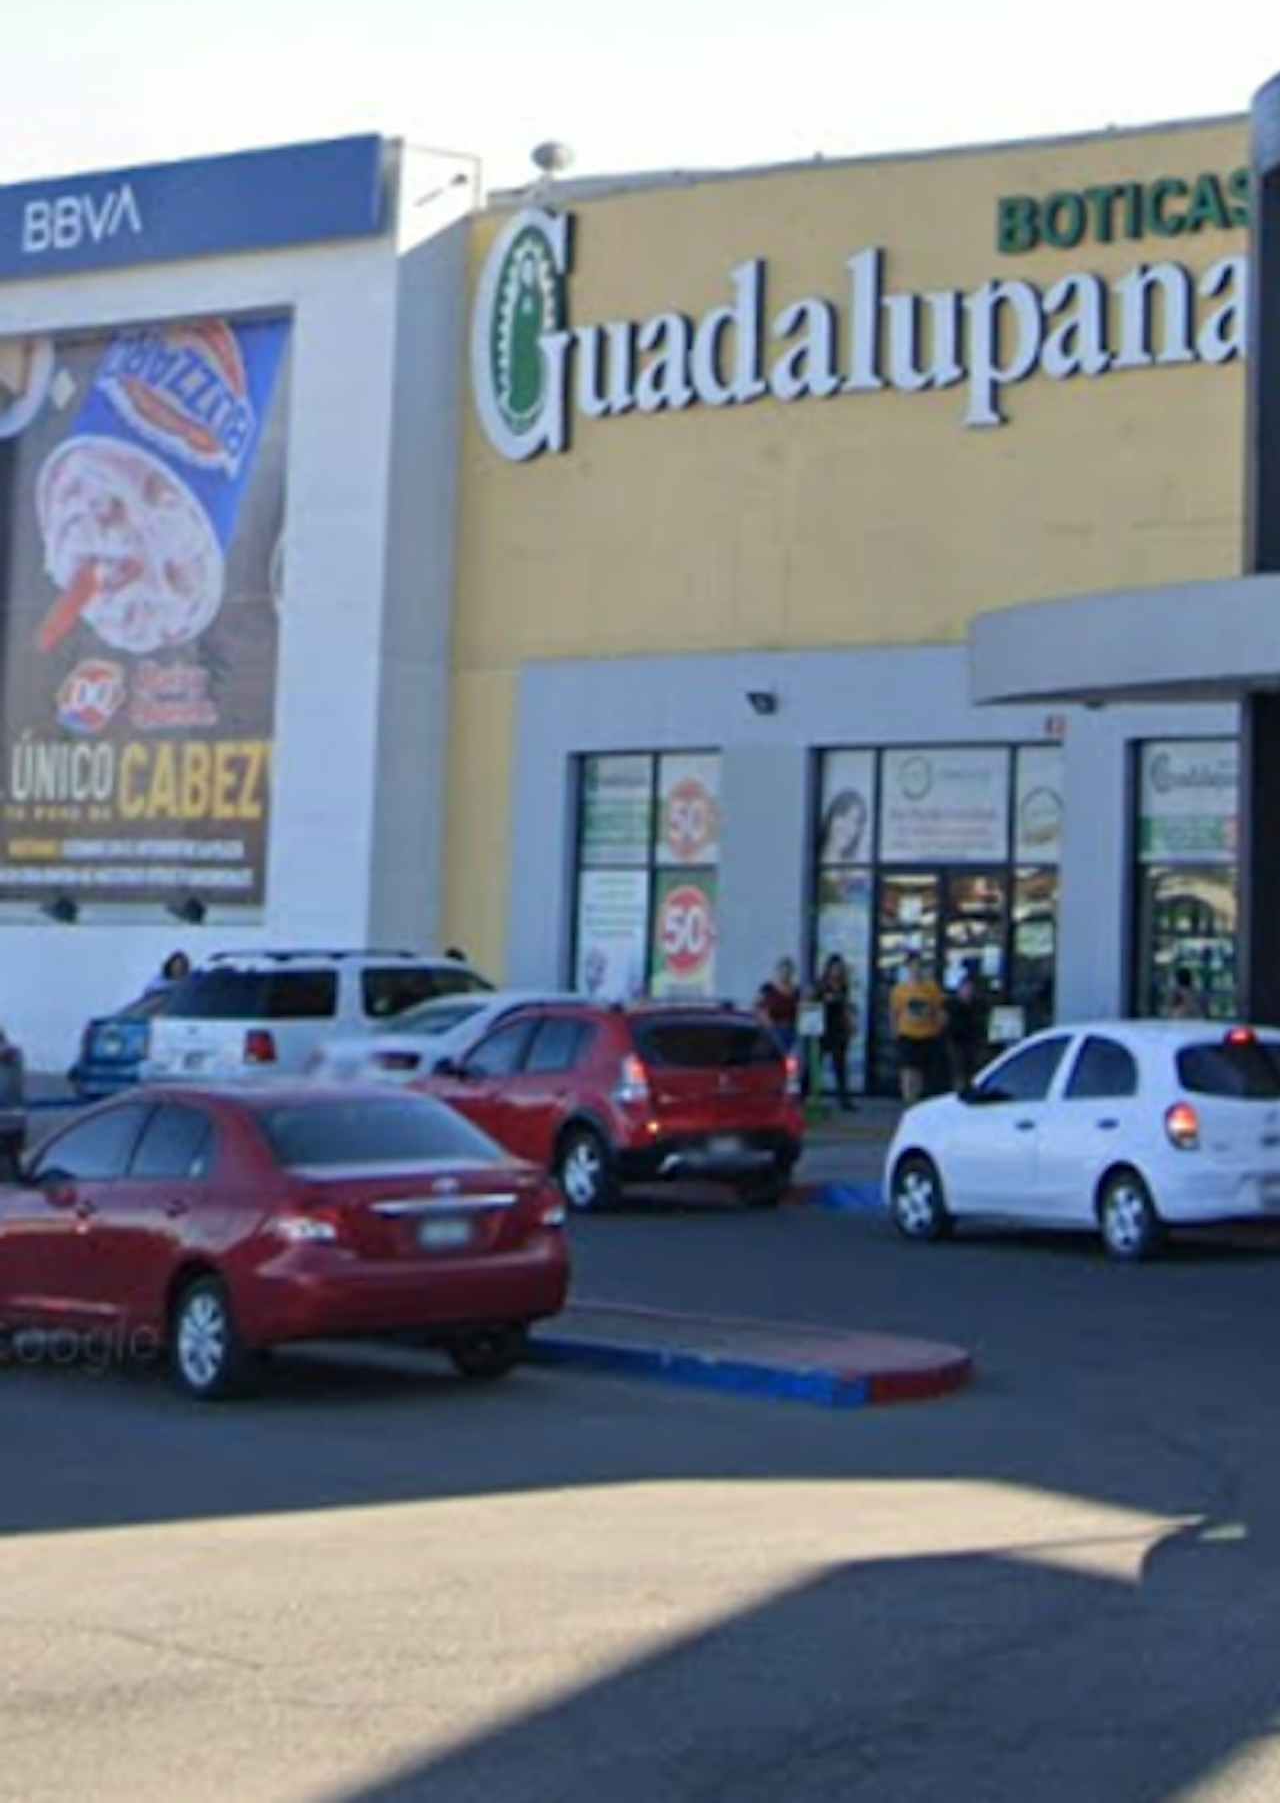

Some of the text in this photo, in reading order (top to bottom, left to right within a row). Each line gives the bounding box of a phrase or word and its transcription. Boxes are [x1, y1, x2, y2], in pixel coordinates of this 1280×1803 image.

[23, 183, 141, 252] BBVA
[998, 169, 1250, 253] BOTICAS
[471, 206, 1249, 461] Guadalupana
[11, 731, 113, 801] ÚNICO
[666, 797, 706, 840] 50
[664, 905, 706, 954] 50
